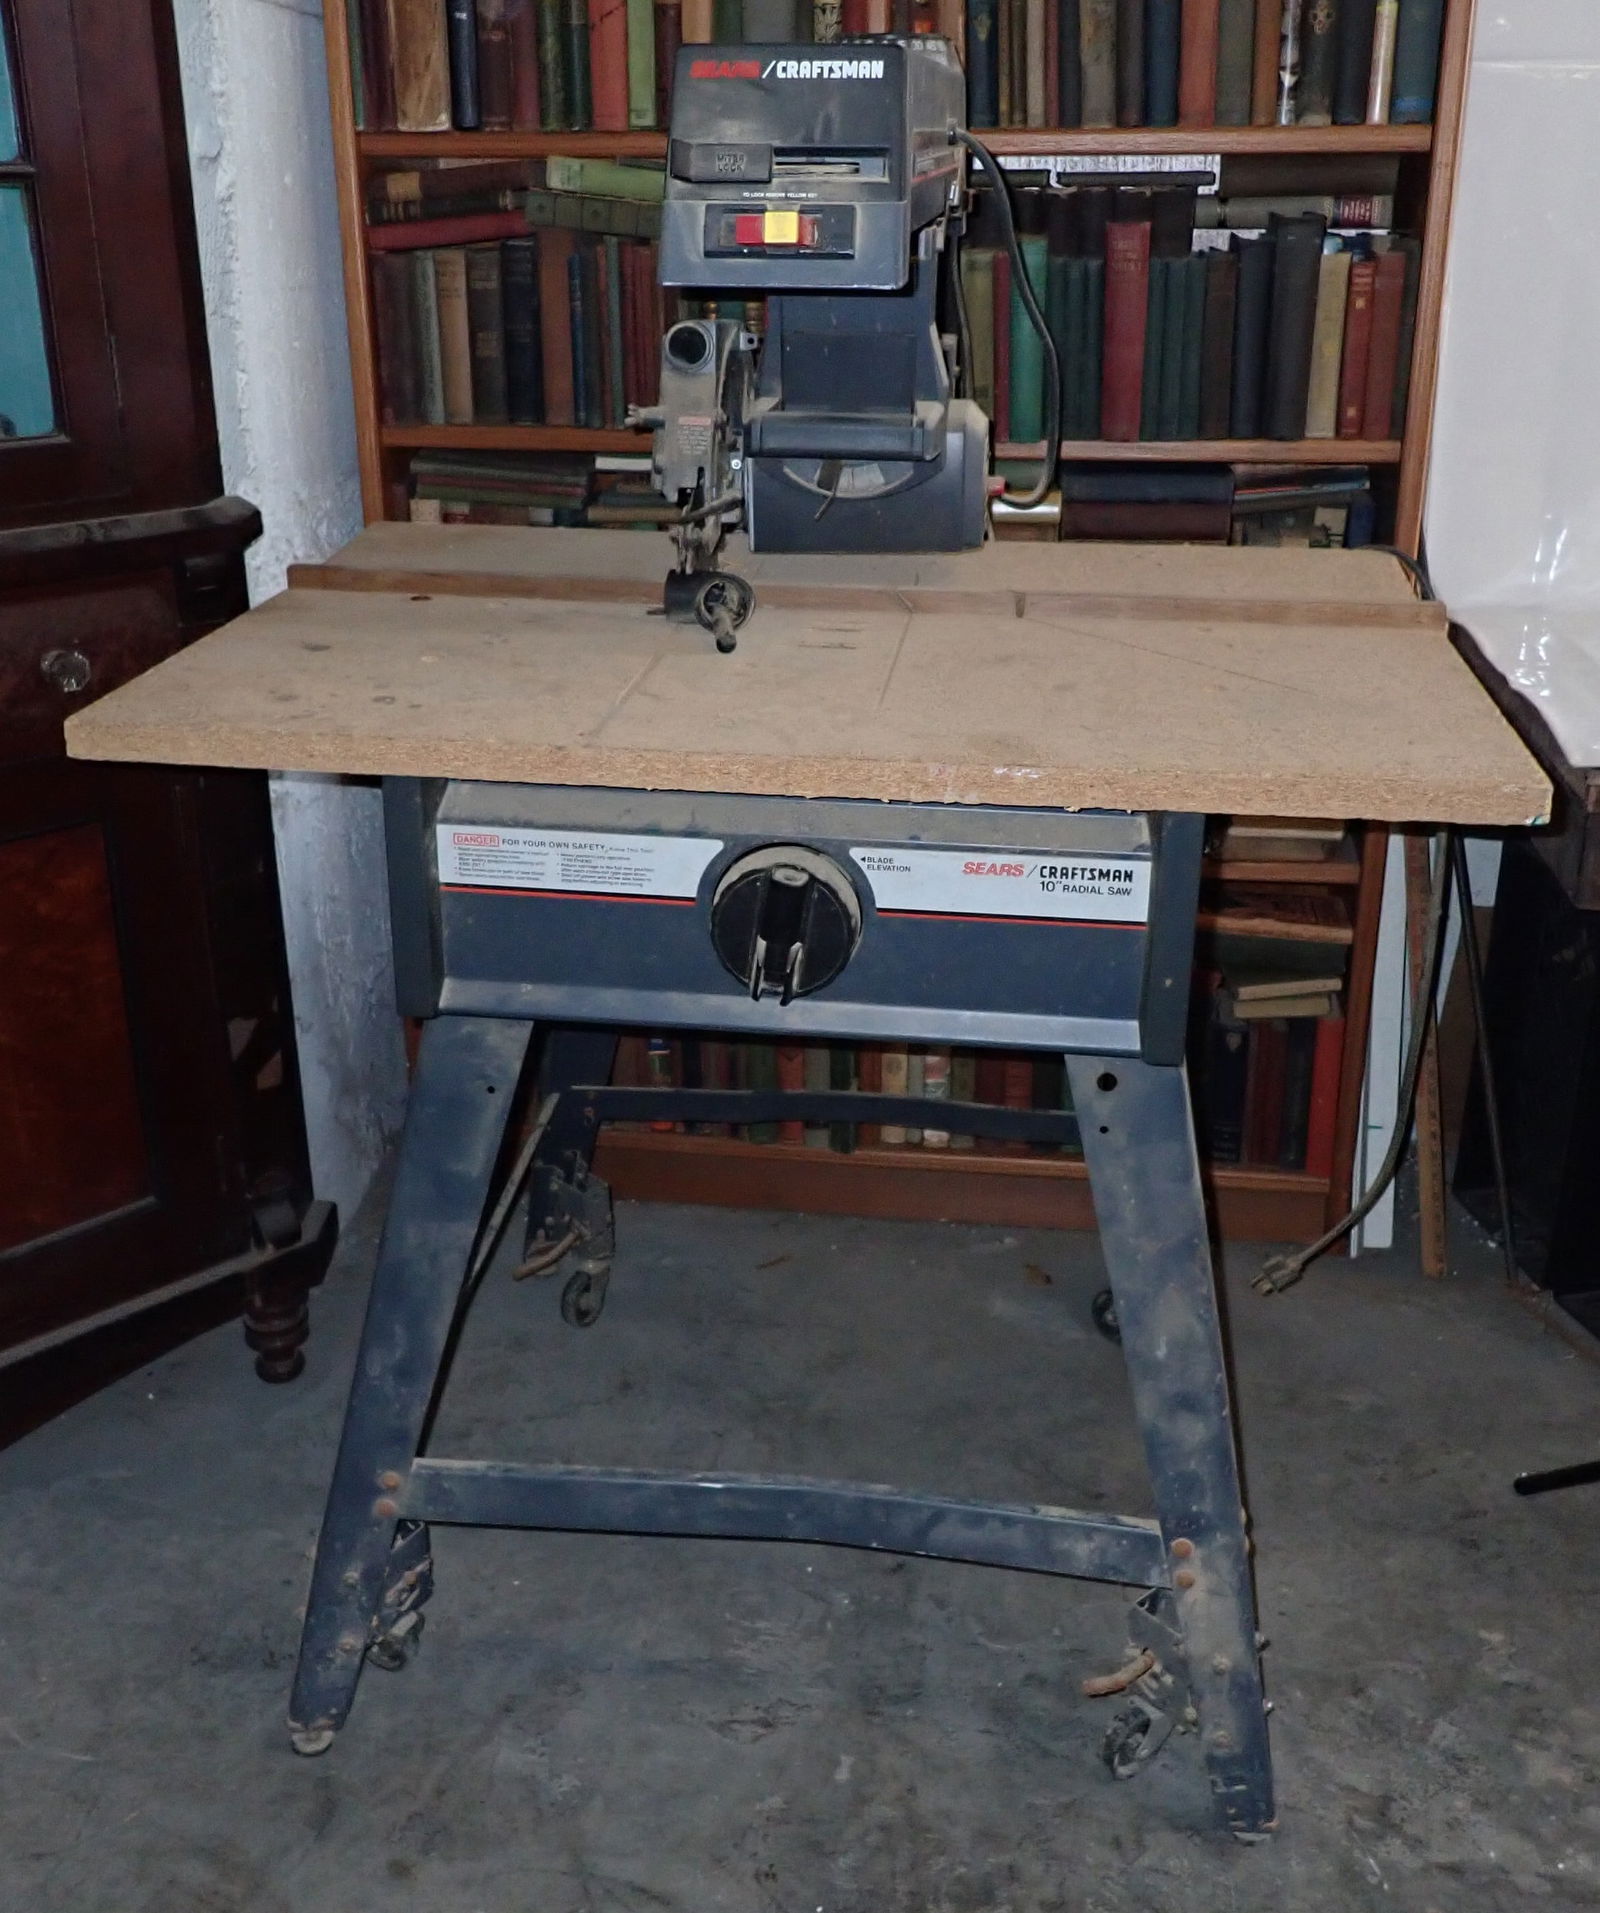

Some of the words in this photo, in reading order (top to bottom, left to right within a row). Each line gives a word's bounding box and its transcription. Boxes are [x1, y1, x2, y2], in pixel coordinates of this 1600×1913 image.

[776, 60, 885, 79] CRAFTSMAN
[456, 835, 497, 845] DANGER
[502, 838, 520, 846] FOR
[522, 839, 546, 848] YOUR
[549, 841, 569, 849] OWN
[866, 856, 894, 864] BLADE
[866, 864, 911, 872] ELEVATION
[962, 861, 1025, 878] SEARS
[1039, 865, 1134, 883] CRAFTSMAN
[1062, 884, 1104, 896] RADIAL
[1107, 886, 1133, 897] SAW
